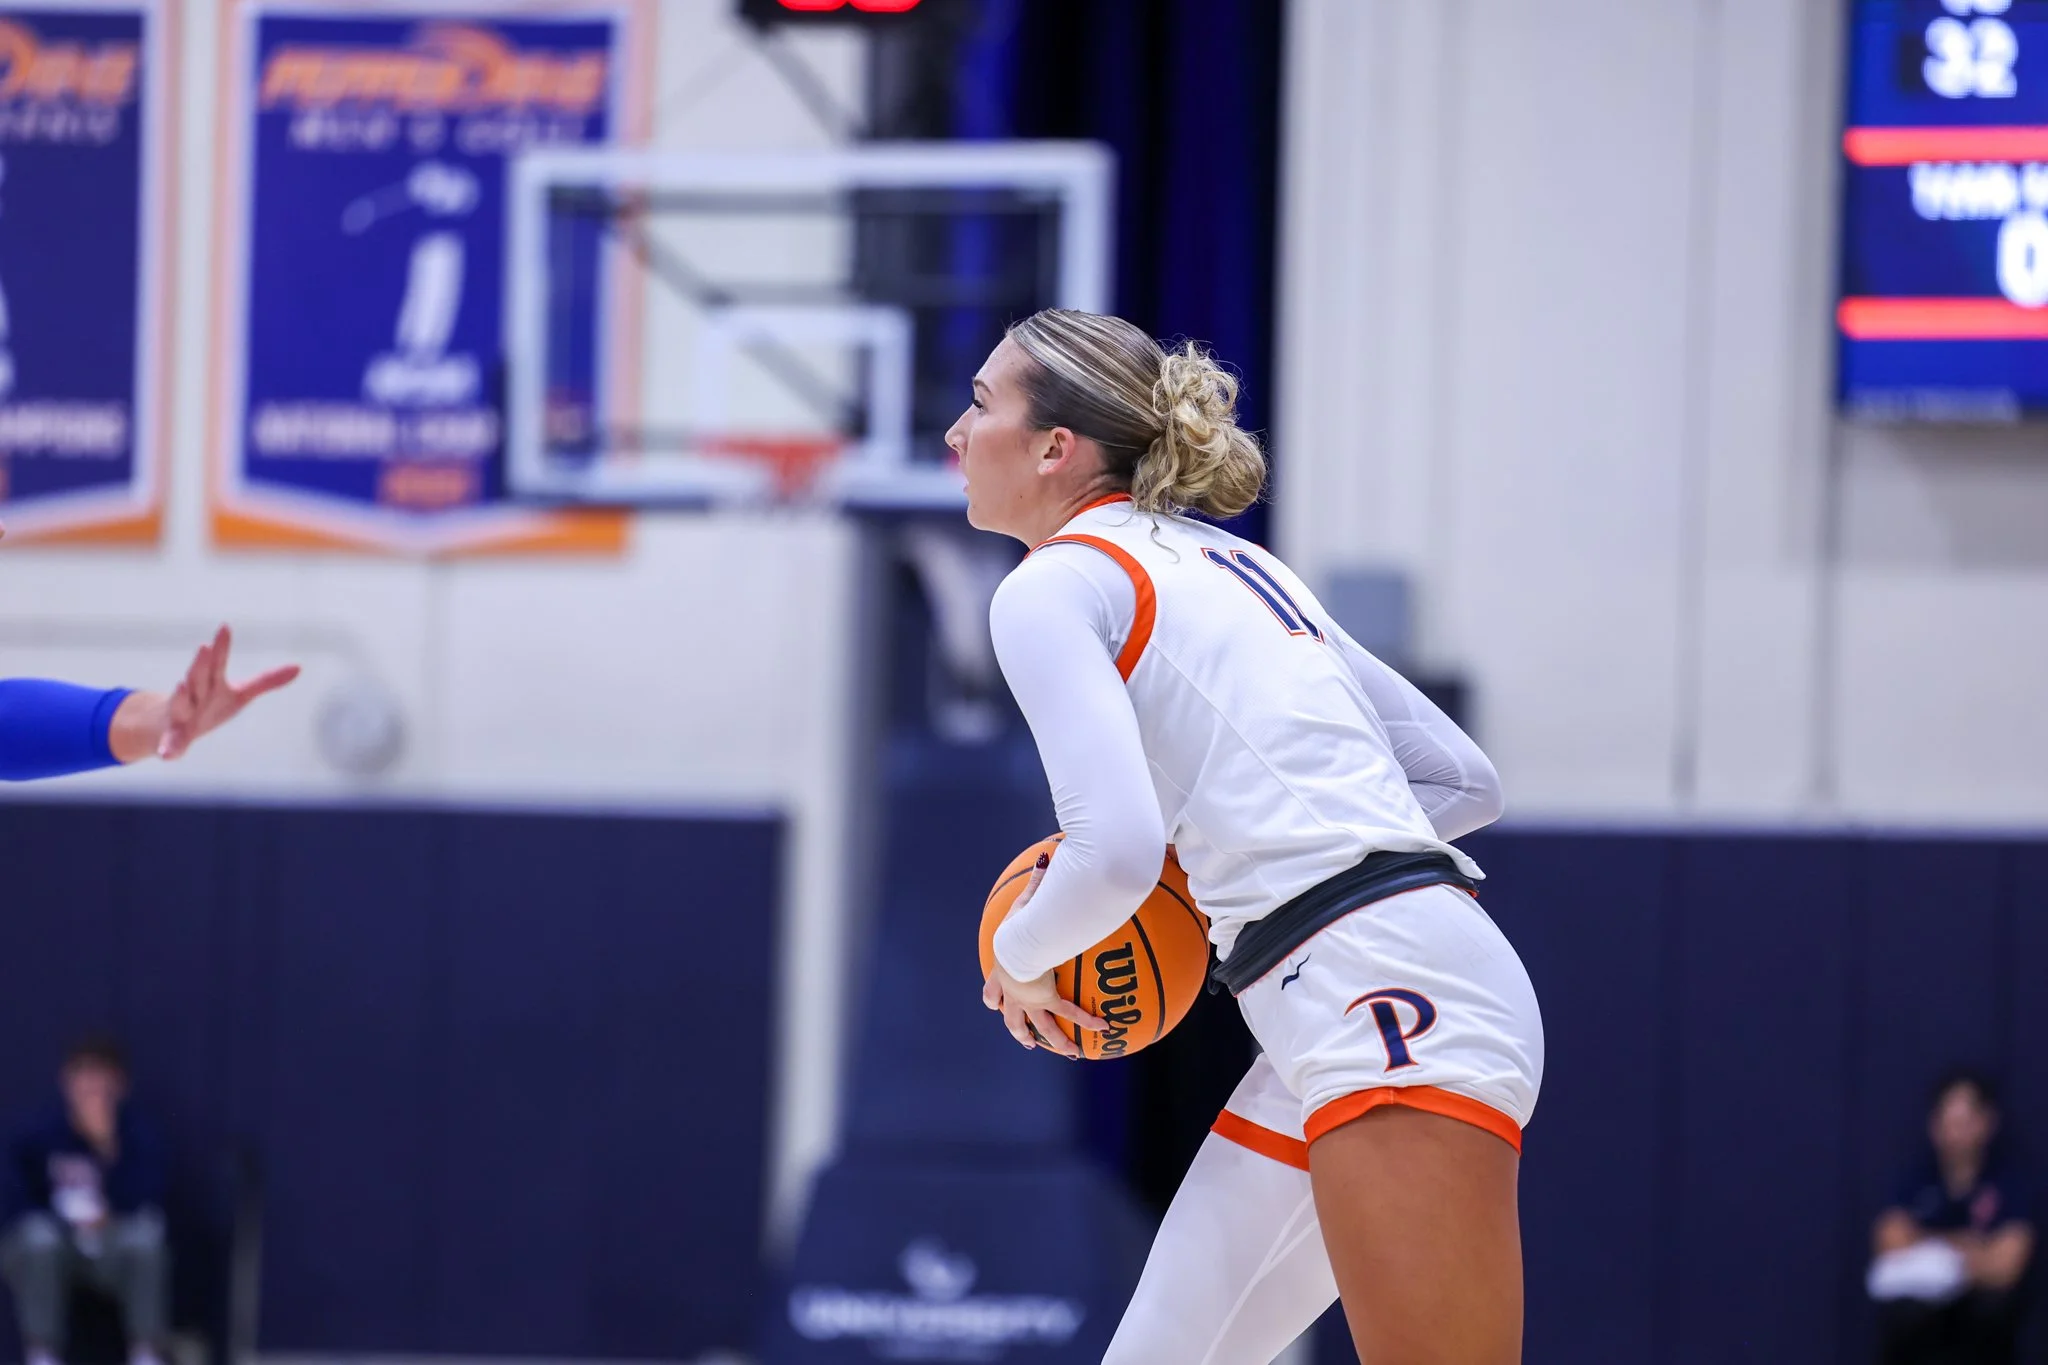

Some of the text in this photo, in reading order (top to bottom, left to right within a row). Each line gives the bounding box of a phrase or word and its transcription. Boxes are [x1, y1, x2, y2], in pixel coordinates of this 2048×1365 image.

[1922, 15, 2019, 98] 32
[1201, 547, 1326, 645] 11
[1343, 987, 1438, 1072] P
